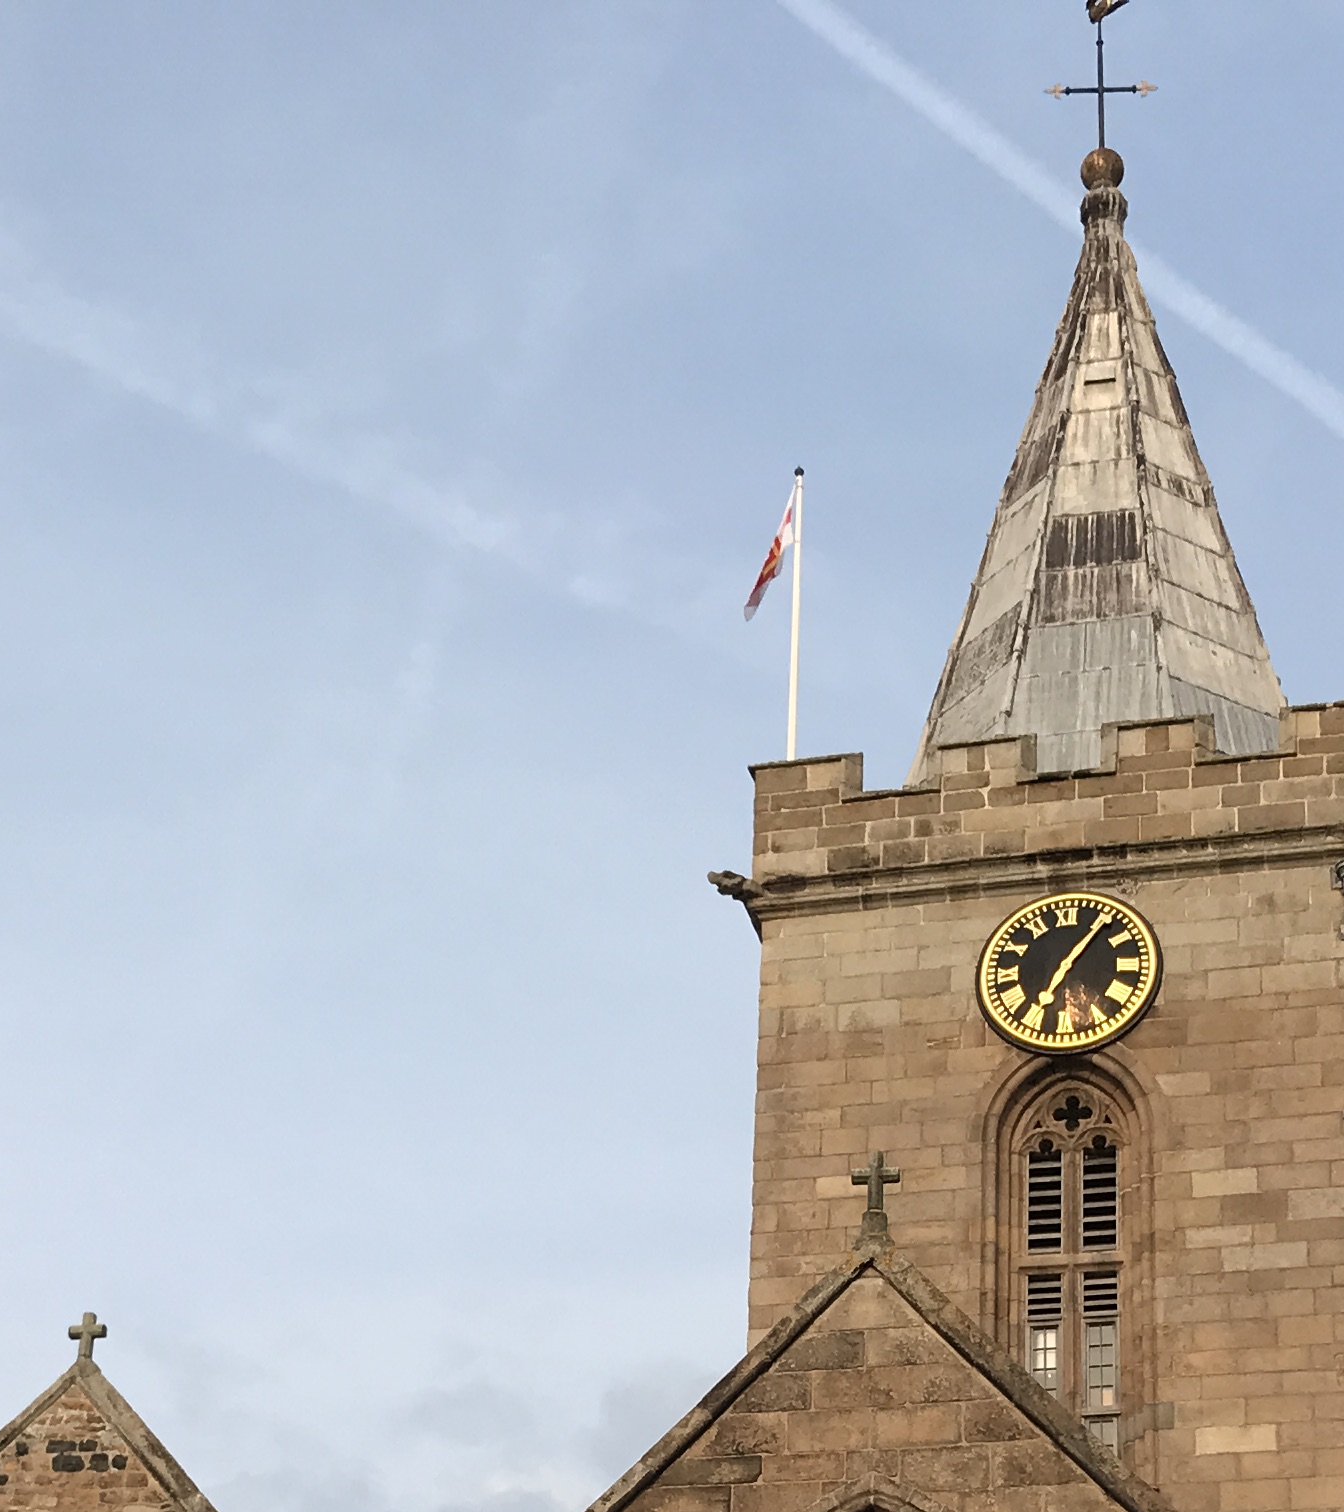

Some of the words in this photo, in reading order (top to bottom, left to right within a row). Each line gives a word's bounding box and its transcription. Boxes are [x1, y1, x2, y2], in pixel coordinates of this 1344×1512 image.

[1054, 907, 1079, 927] XII
[1023, 915, 1050, 940] XI
[1002, 940, 1029, 957] X
[1116, 956, 1140, 973] III
